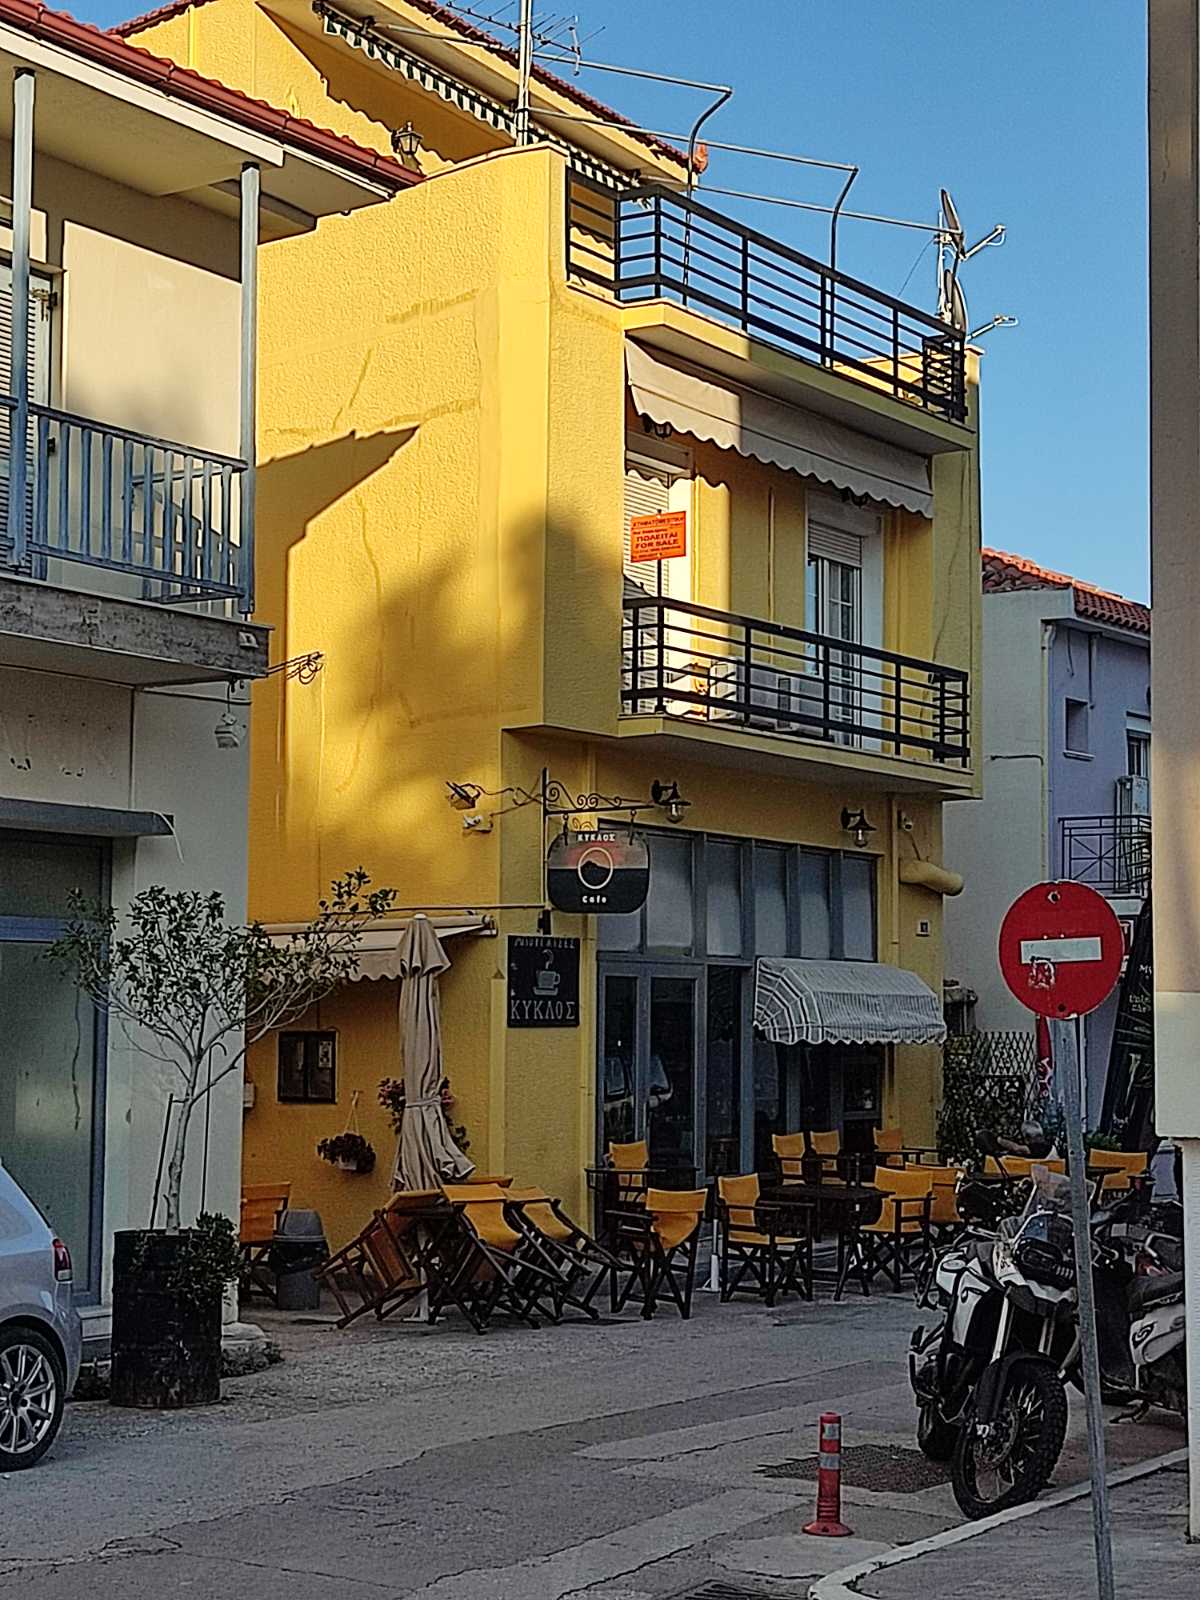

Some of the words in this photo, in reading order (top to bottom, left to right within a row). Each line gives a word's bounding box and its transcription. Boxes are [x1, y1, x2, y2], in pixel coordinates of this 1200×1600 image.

[655, 539, 679, 547] SALE
[577, 833, 616, 842] ΚΥΚΛΟΣ
[582, 895, 607, 904] Cafe
[510, 1000, 576, 1019] ΚΥΚΛΟΣ
